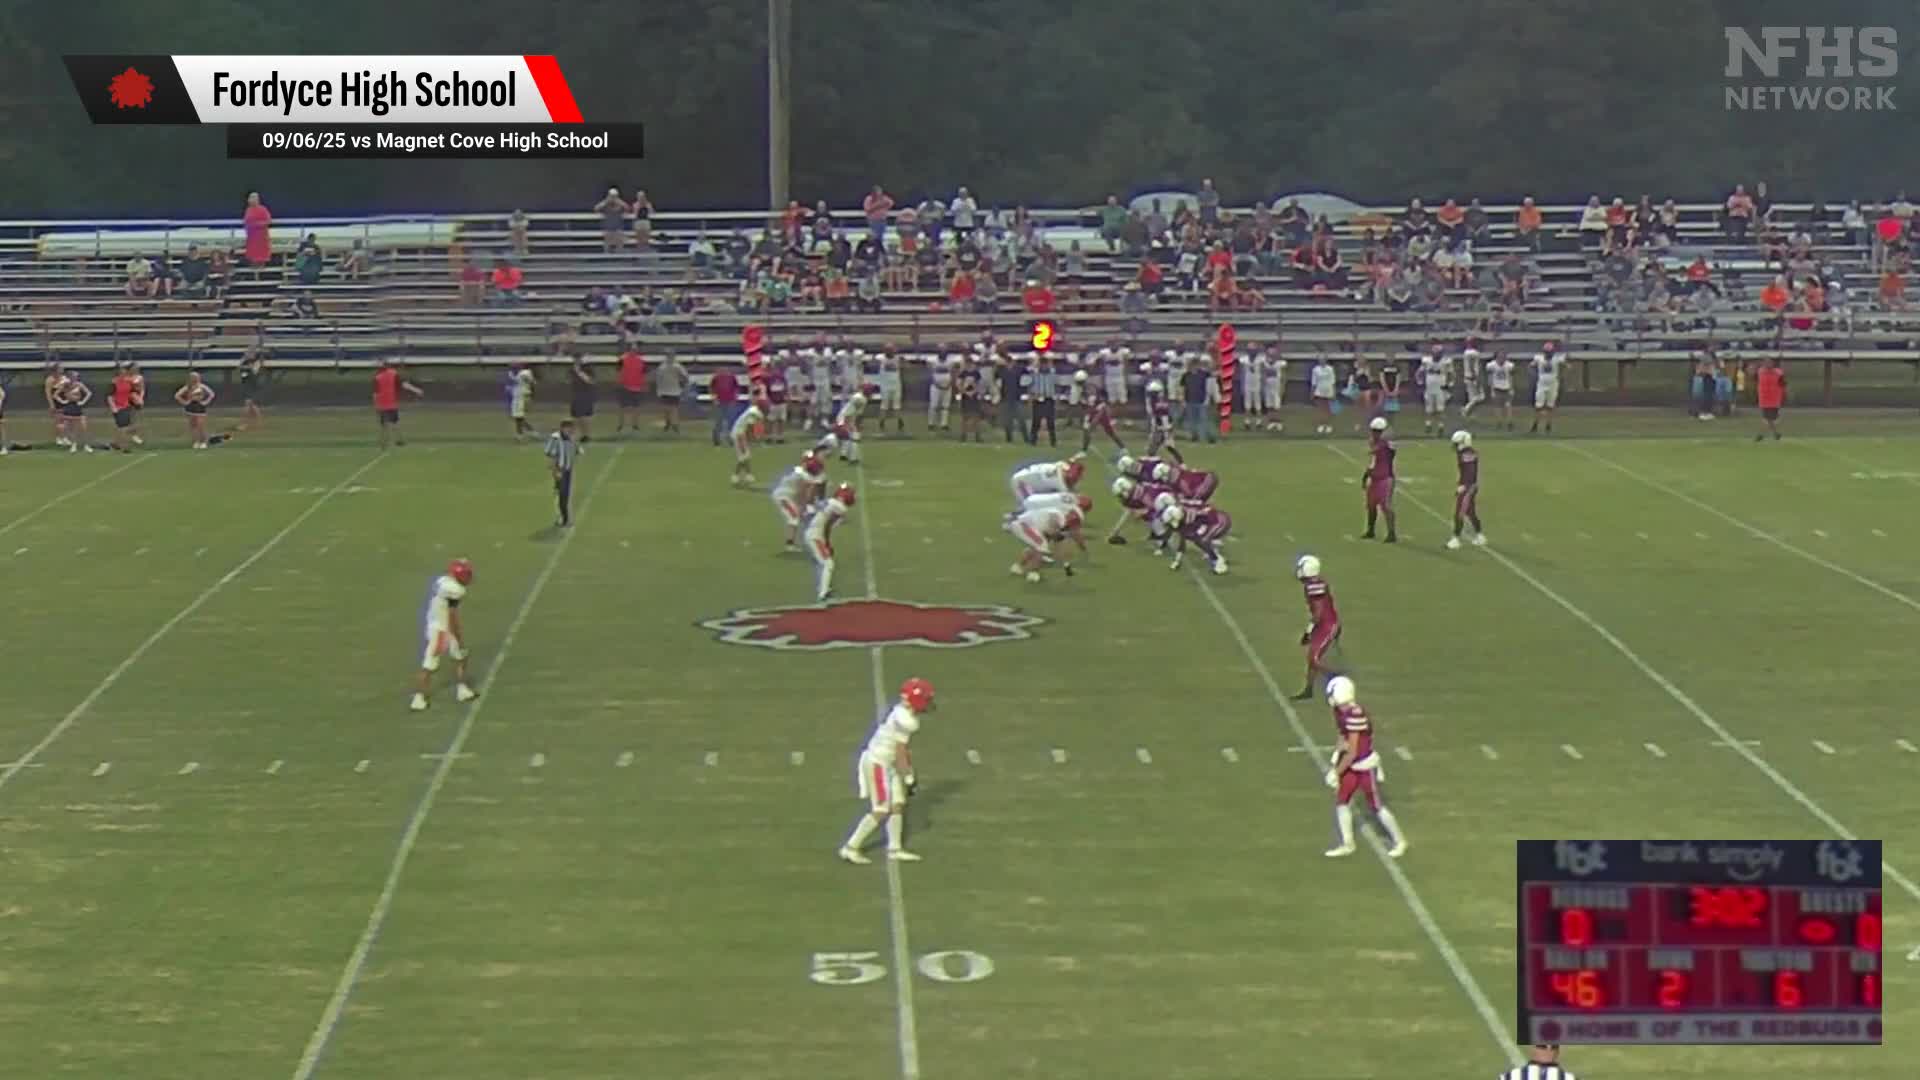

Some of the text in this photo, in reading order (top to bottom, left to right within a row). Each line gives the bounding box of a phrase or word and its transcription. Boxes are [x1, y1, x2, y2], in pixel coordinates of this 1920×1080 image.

[1032, 322, 1051, 349] 2
[1641, 840, 1784, 870] bank simply
[1551, 971, 1601, 1008] 46
[1659, 970, 1685, 1008] 2
[1774, 970, 1801, 1008] 6
[1566, 1020, 1859, 1039] HOME OF THE REDBUGS
